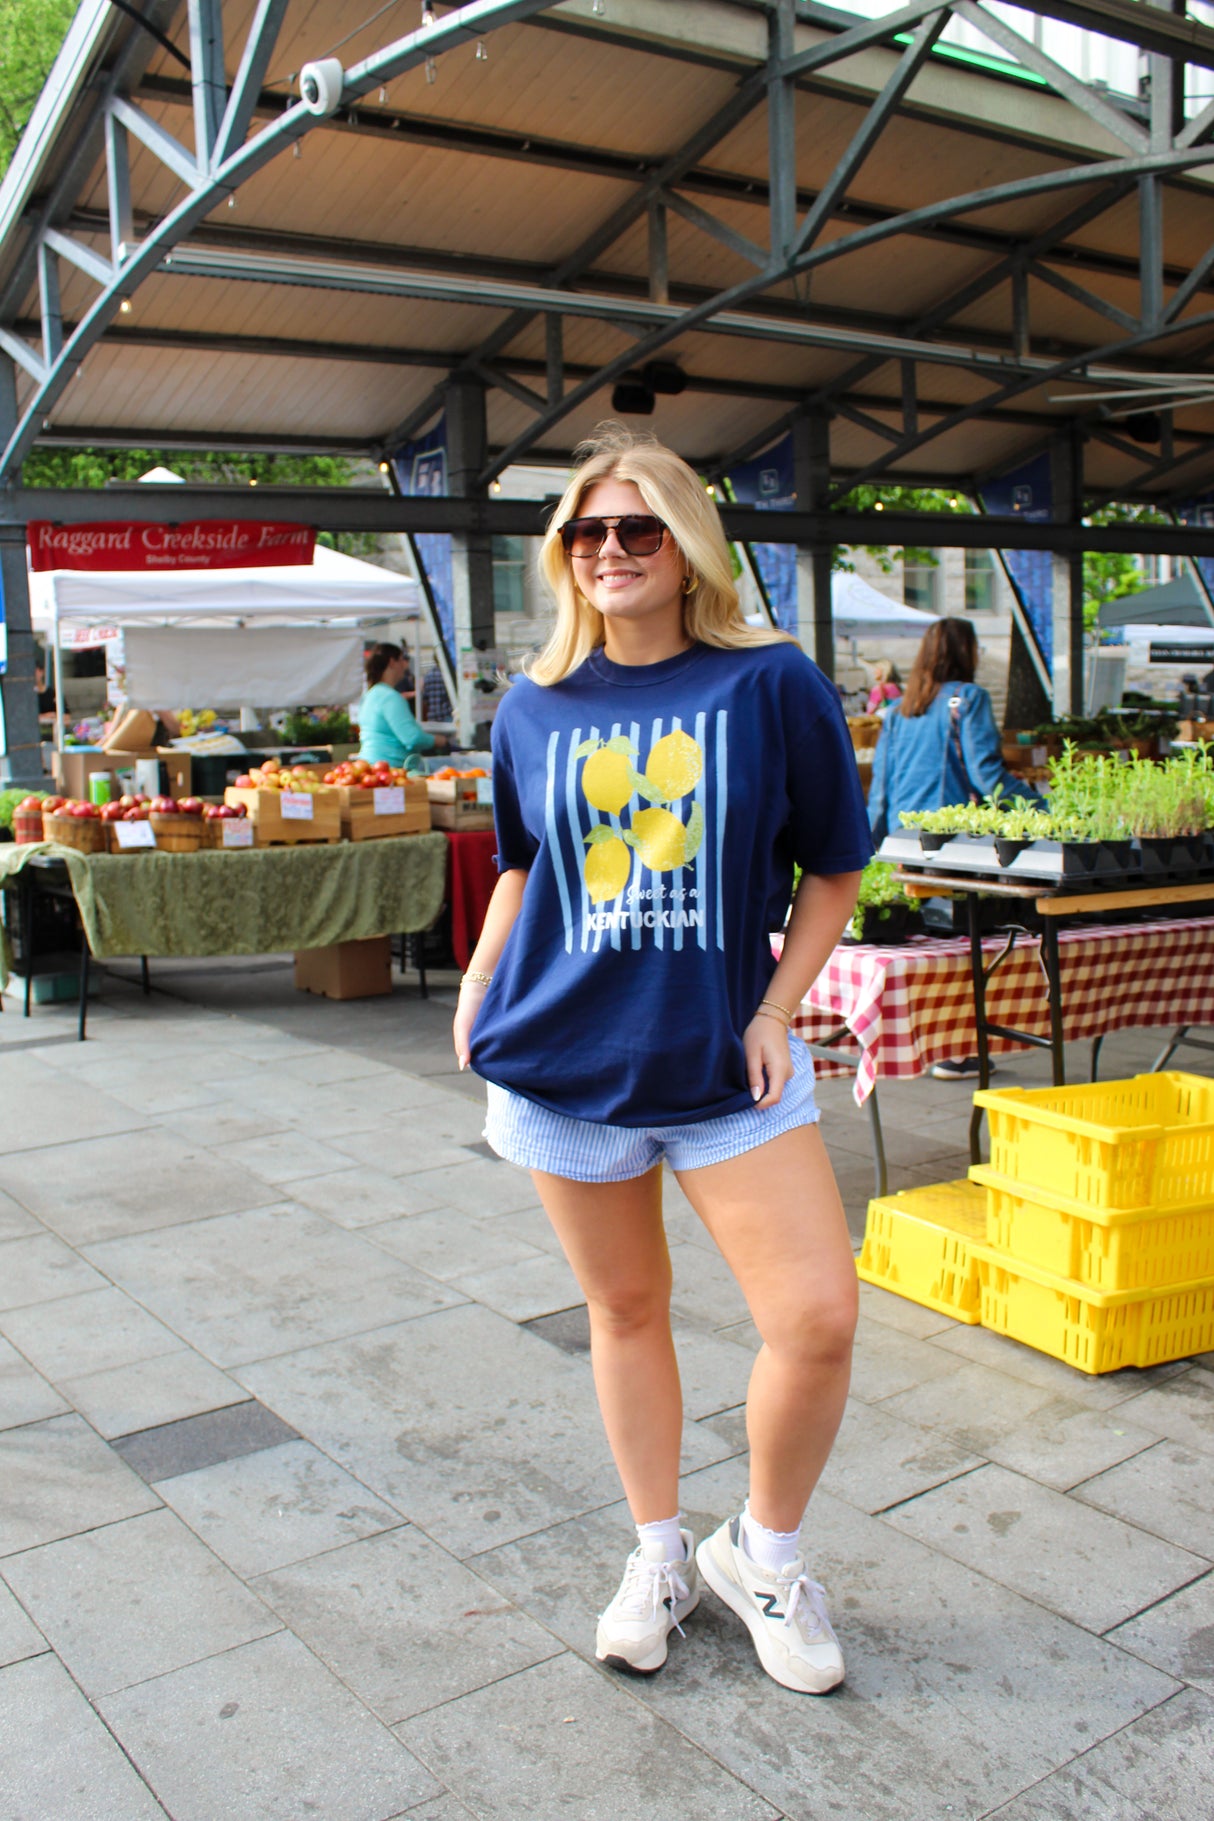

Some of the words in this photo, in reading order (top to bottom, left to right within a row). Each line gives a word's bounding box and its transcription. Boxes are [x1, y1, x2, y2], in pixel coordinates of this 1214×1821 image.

[39, 526, 133, 555] Raggard
[142, 524, 249, 550] Creekside
[257, 526, 308, 547] Farm
[146, 554, 176, 564] Shelby
[178, 555, 210, 564] County
[626, 884, 667, 904] Sweet
[669, 888, 687, 900] as
[689, 888, 702, 898] a
[587, 909, 704, 931] KENTUCKIAN
